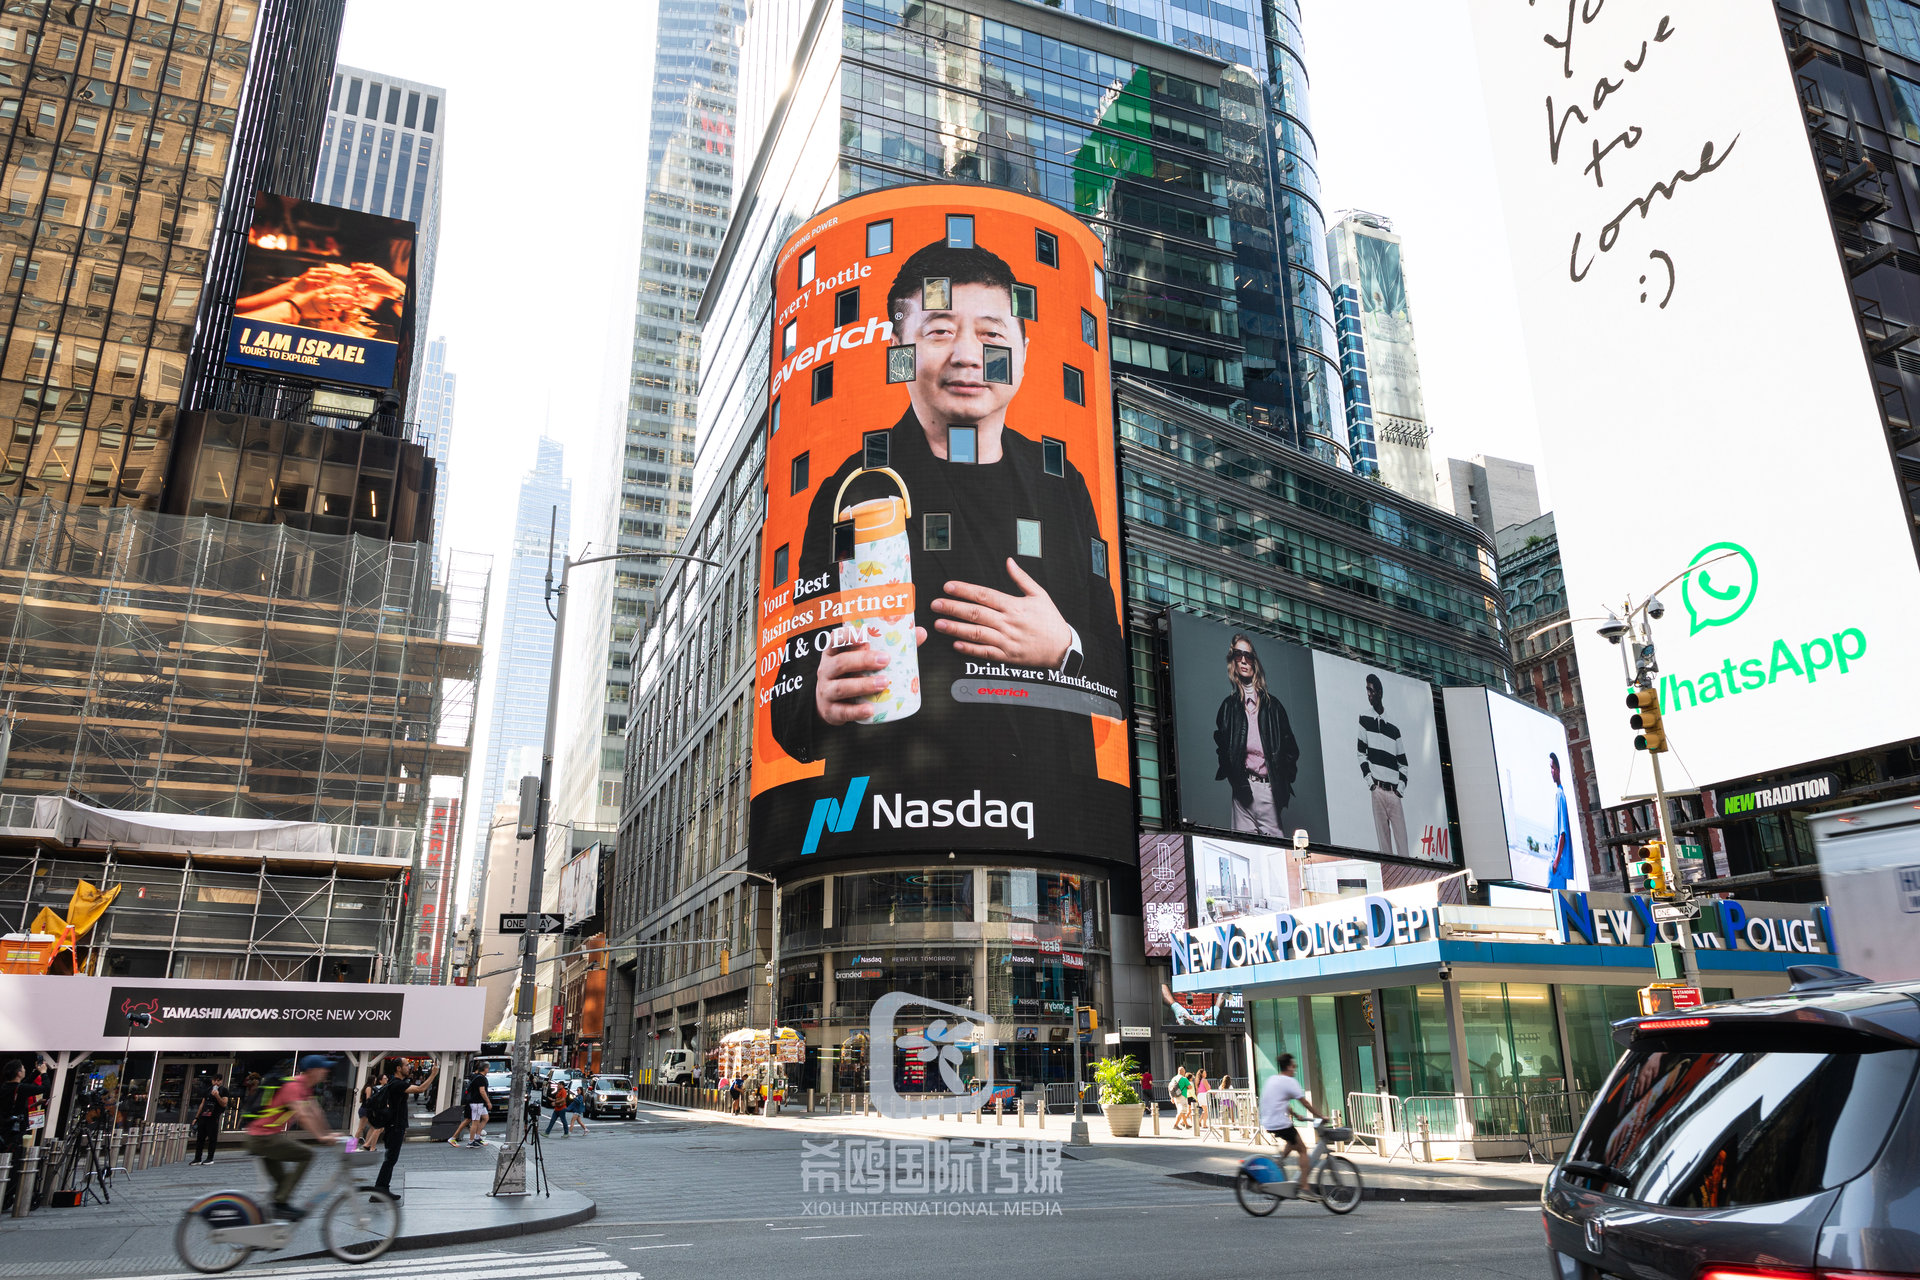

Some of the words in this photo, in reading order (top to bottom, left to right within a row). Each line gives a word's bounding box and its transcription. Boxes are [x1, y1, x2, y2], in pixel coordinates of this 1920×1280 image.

[1546, 15, 1675, 165] have
[1584, 126, 1642, 187] to
[811, 216, 838, 237] POWER
[1570, 130, 1741, 282] come
[778, 288, 812, 326] every
[815, 261, 872, 297] bottle
[239, 344, 267, 357] YOURS
[269, 349, 280, 359] TO
[281, 352, 320, 366] EXPLORE.
[240, 327, 251, 344] I
[253, 330, 292, 351] AM
[296, 337, 365, 364] ISRAEL
[771, 317, 894, 396] everich
[763, 589, 789, 618] Your
[793, 572, 830, 600] Best
[762, 610, 813, 648] Business
[819, 593, 908, 621] Partner
[761, 640, 790, 677] ODM
[794, 637, 810, 658] &
[814, 623, 869, 652] OEM
[759, 674, 803, 708] Service
[965, 662, 1044, 680] Drinkware
[1048, 669, 1118, 699] Manufacturer
[977, 687, 1029, 698] everich
[873, 789, 1034, 840] Nasdaq
[1724, 777, 1830, 815] NEWTRADITION
[427, 807, 447, 867] PARK
[1421, 825, 1448, 859] H&M
[1154, 881, 1175, 891] EOS
[415, 904, 436, 966] PARK
[506, 917, 525, 928] ONE
[538, 918, 552, 928] AY
[1171, 931, 1217, 975] NEW
[1214, 923, 1275, 969] YORK
[1276, 913, 1358, 962] POLICE
[1365, 895, 1440, 948] DEPT
[1553, 889, 1633, 945] NEW
[1718, 900, 1822, 953] POLICE
[860, 956, 882, 964] Nasdaq
[1012, 955, 1035, 964] Nasdaq
[162, 1007, 221, 1019] TAMASHII
[281, 1008, 323, 1021] STORE
[326, 1009, 356, 1020] NEW
[357, 1010, 391, 1021] YORK
